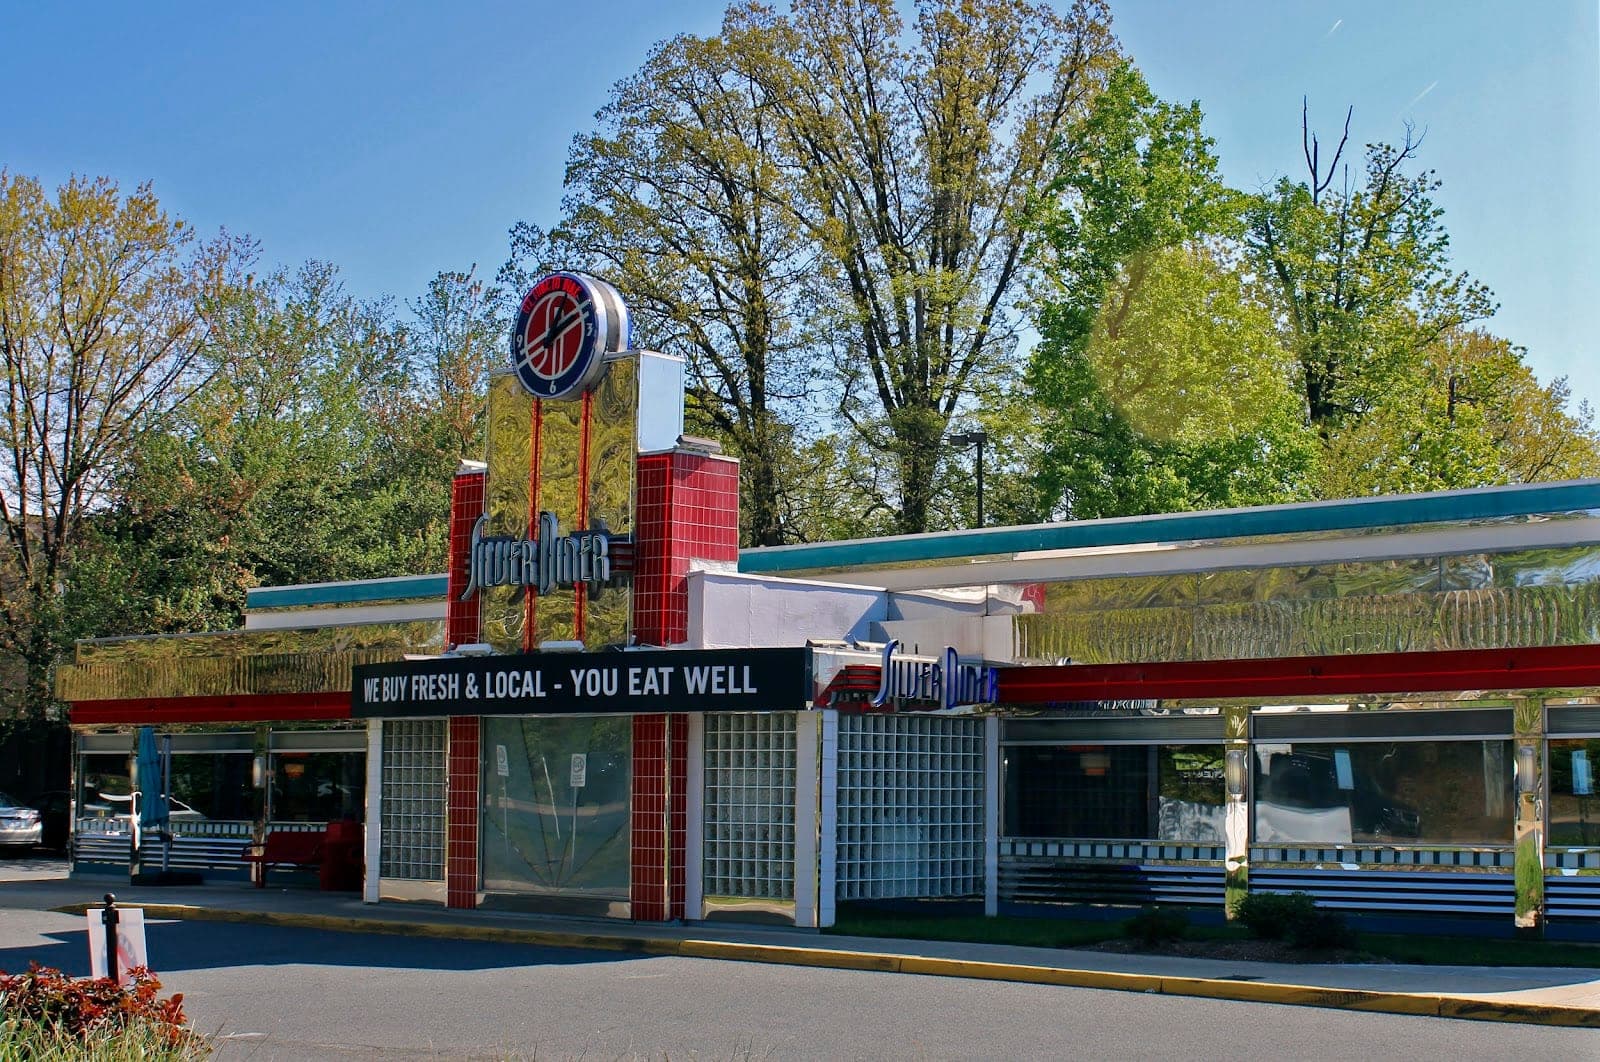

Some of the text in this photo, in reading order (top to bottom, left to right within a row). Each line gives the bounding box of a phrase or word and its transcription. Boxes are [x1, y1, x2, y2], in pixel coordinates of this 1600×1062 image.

[516, 334, 524, 353] 9
[549, 380, 557, 394] 6
[364, 678, 380, 703] WE
[382, 675, 406, 702] BUY
[411, 673, 459, 701] FRESH
[465, 672, 479, 699] &
[485, 670, 546, 699] LOCAL
[570, 668, 618, 697] YOU
[629, 666, 675, 696] EAT
[684, 665, 757, 695] WELL
